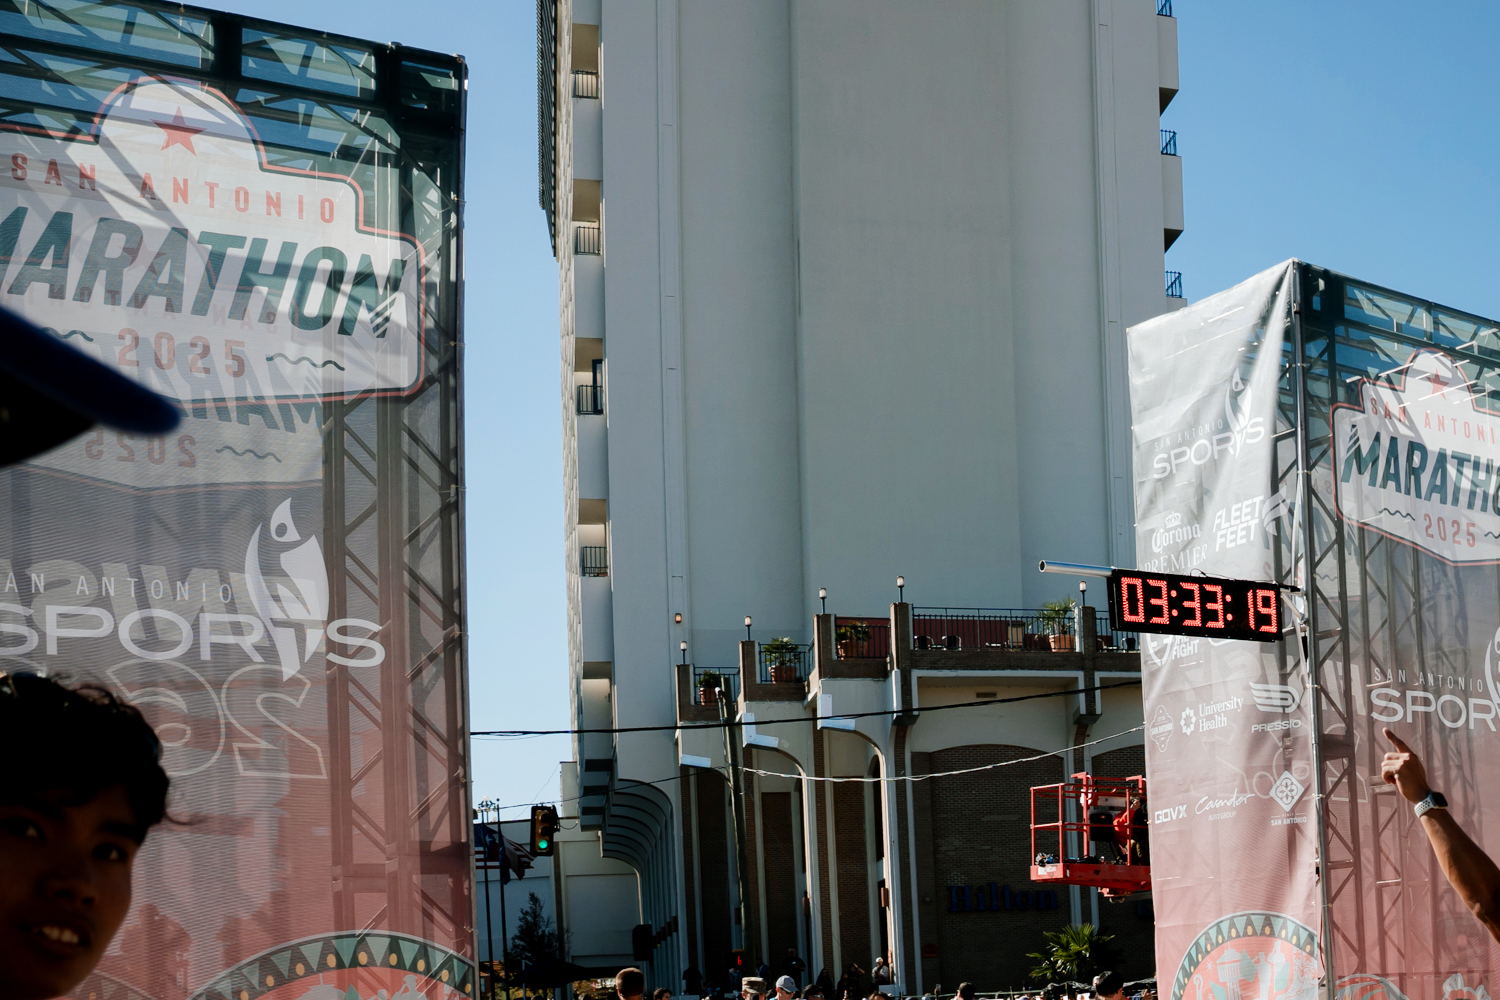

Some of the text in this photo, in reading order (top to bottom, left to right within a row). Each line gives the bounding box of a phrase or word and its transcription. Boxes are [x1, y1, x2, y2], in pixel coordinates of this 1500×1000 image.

[12, 152, 335, 224] SAN ANTONIO
[117, 327, 246, 378] 2025
[1371, 396, 1408, 424] SAN
[1152, 417, 1265, 479] SPORTS
[1213, 495, 1264, 533] FLEET
[1151, 522, 1202, 554] Corona
[1215, 518, 1260, 552] FEET
[1423, 513, 1476, 547] 2025
[1144, 543, 1208, 574] PREMIER
[76, 573, 234, 604] ANTONIO
[1121, 576, 1278, 634] 03:33:19
[0, 604, 386, 674] SPORTS
[1172, 639, 1200, 660] FIGHT
[1374, 667, 1406, 683] SAN
[1419, 671, 1483, 693] ANTONIO
[1199, 696, 1244, 717] University
[1199, 713, 1227, 732] Health
[1251, 719, 1302, 734] PRESSIO
[1154, 804, 1188, 825] GOVX
[1195, 788, 1256, 815] Cavender
[1270, 816, 1307, 827] SAN ANTONIO
[947, 882, 1059, 912] Hilton
